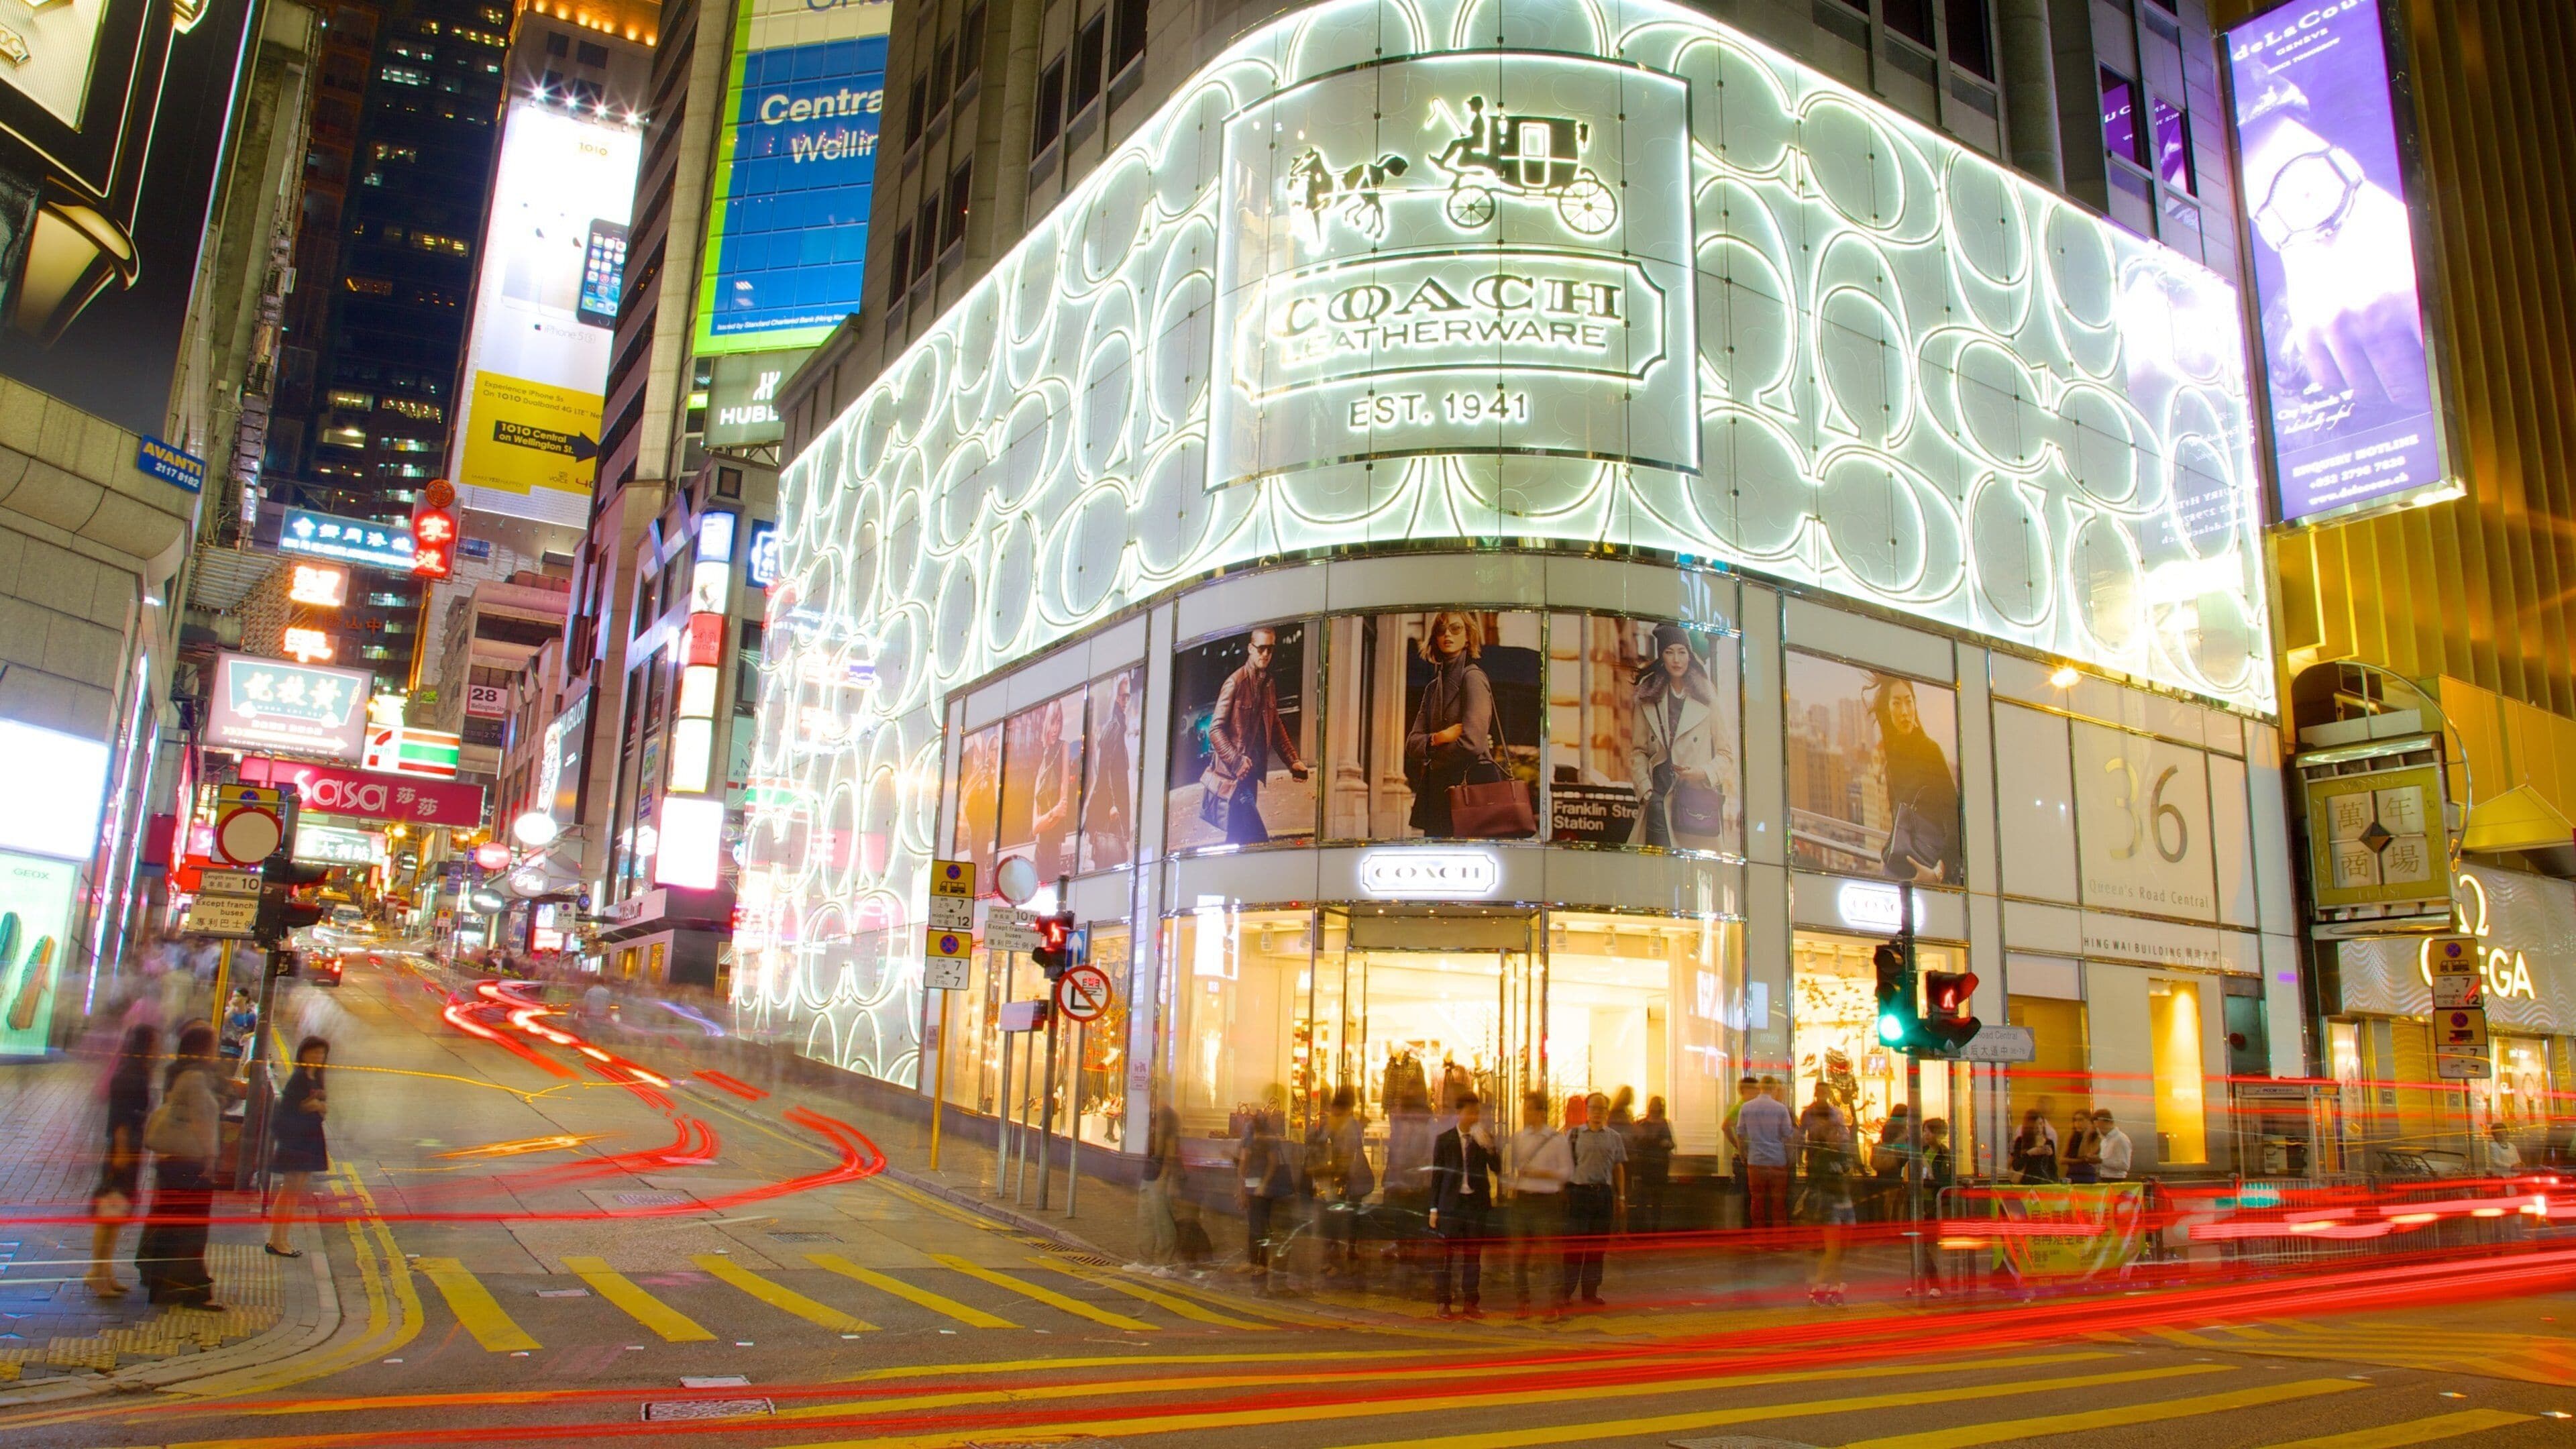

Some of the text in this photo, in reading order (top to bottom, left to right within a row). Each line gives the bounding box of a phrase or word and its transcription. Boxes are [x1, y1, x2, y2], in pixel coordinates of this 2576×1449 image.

[2233, 0, 2367, 61] deLaCou
[1287, 274, 1622, 337] COACH
[744, 319, 770, 329] Standard
[771, 318, 799, 327] Chartered
[800, 316, 814, 325] Bank
[544, 324, 577, 340] iPhone
[485, 381, 527, 394] Experience
[529, 390, 553, 400] iPhone
[483, 390, 494, 398] On
[497, 391, 521, 402] 1010
[523, 398, 559, 411] Dualband
[561, 405, 572, 413] 4G
[1350, 392, 1525, 427] EST. 1941
[501, 423, 567, 443] 1010 Central
[499, 433, 574, 454] on Wellington St.
[143, 441, 202, 477] AVANTI
[154, 462, 199, 488] 2117 8182
[472, 688, 497, 702] 28
[471, 703, 496, 711] Wellington
[559, 694, 589, 738] HUBLOT
[1554, 802, 1607, 816] Franklin
[2105, 757, 2188, 863] 36
[1554, 816, 1604, 830] Station
[13, 868, 49, 879] GEOX
[241, 878, 259, 890] 10
[2089, 879, 2209, 908] Queen's Road Central
[195, 900, 225, 908] Except
[957, 900, 965, 909] 7
[957, 916, 969, 926] 12
[1016, 912, 1028, 920] 10
[2084, 938, 2182, 957] HING WAI BUILDING
[955, 960, 961, 971] 7
[953, 976, 961, 987] 7
[2463, 977, 2470, 987] 7
[1996, 1031, 2018, 1040] Central
[2470, 1049, 2477, 1057] 7
